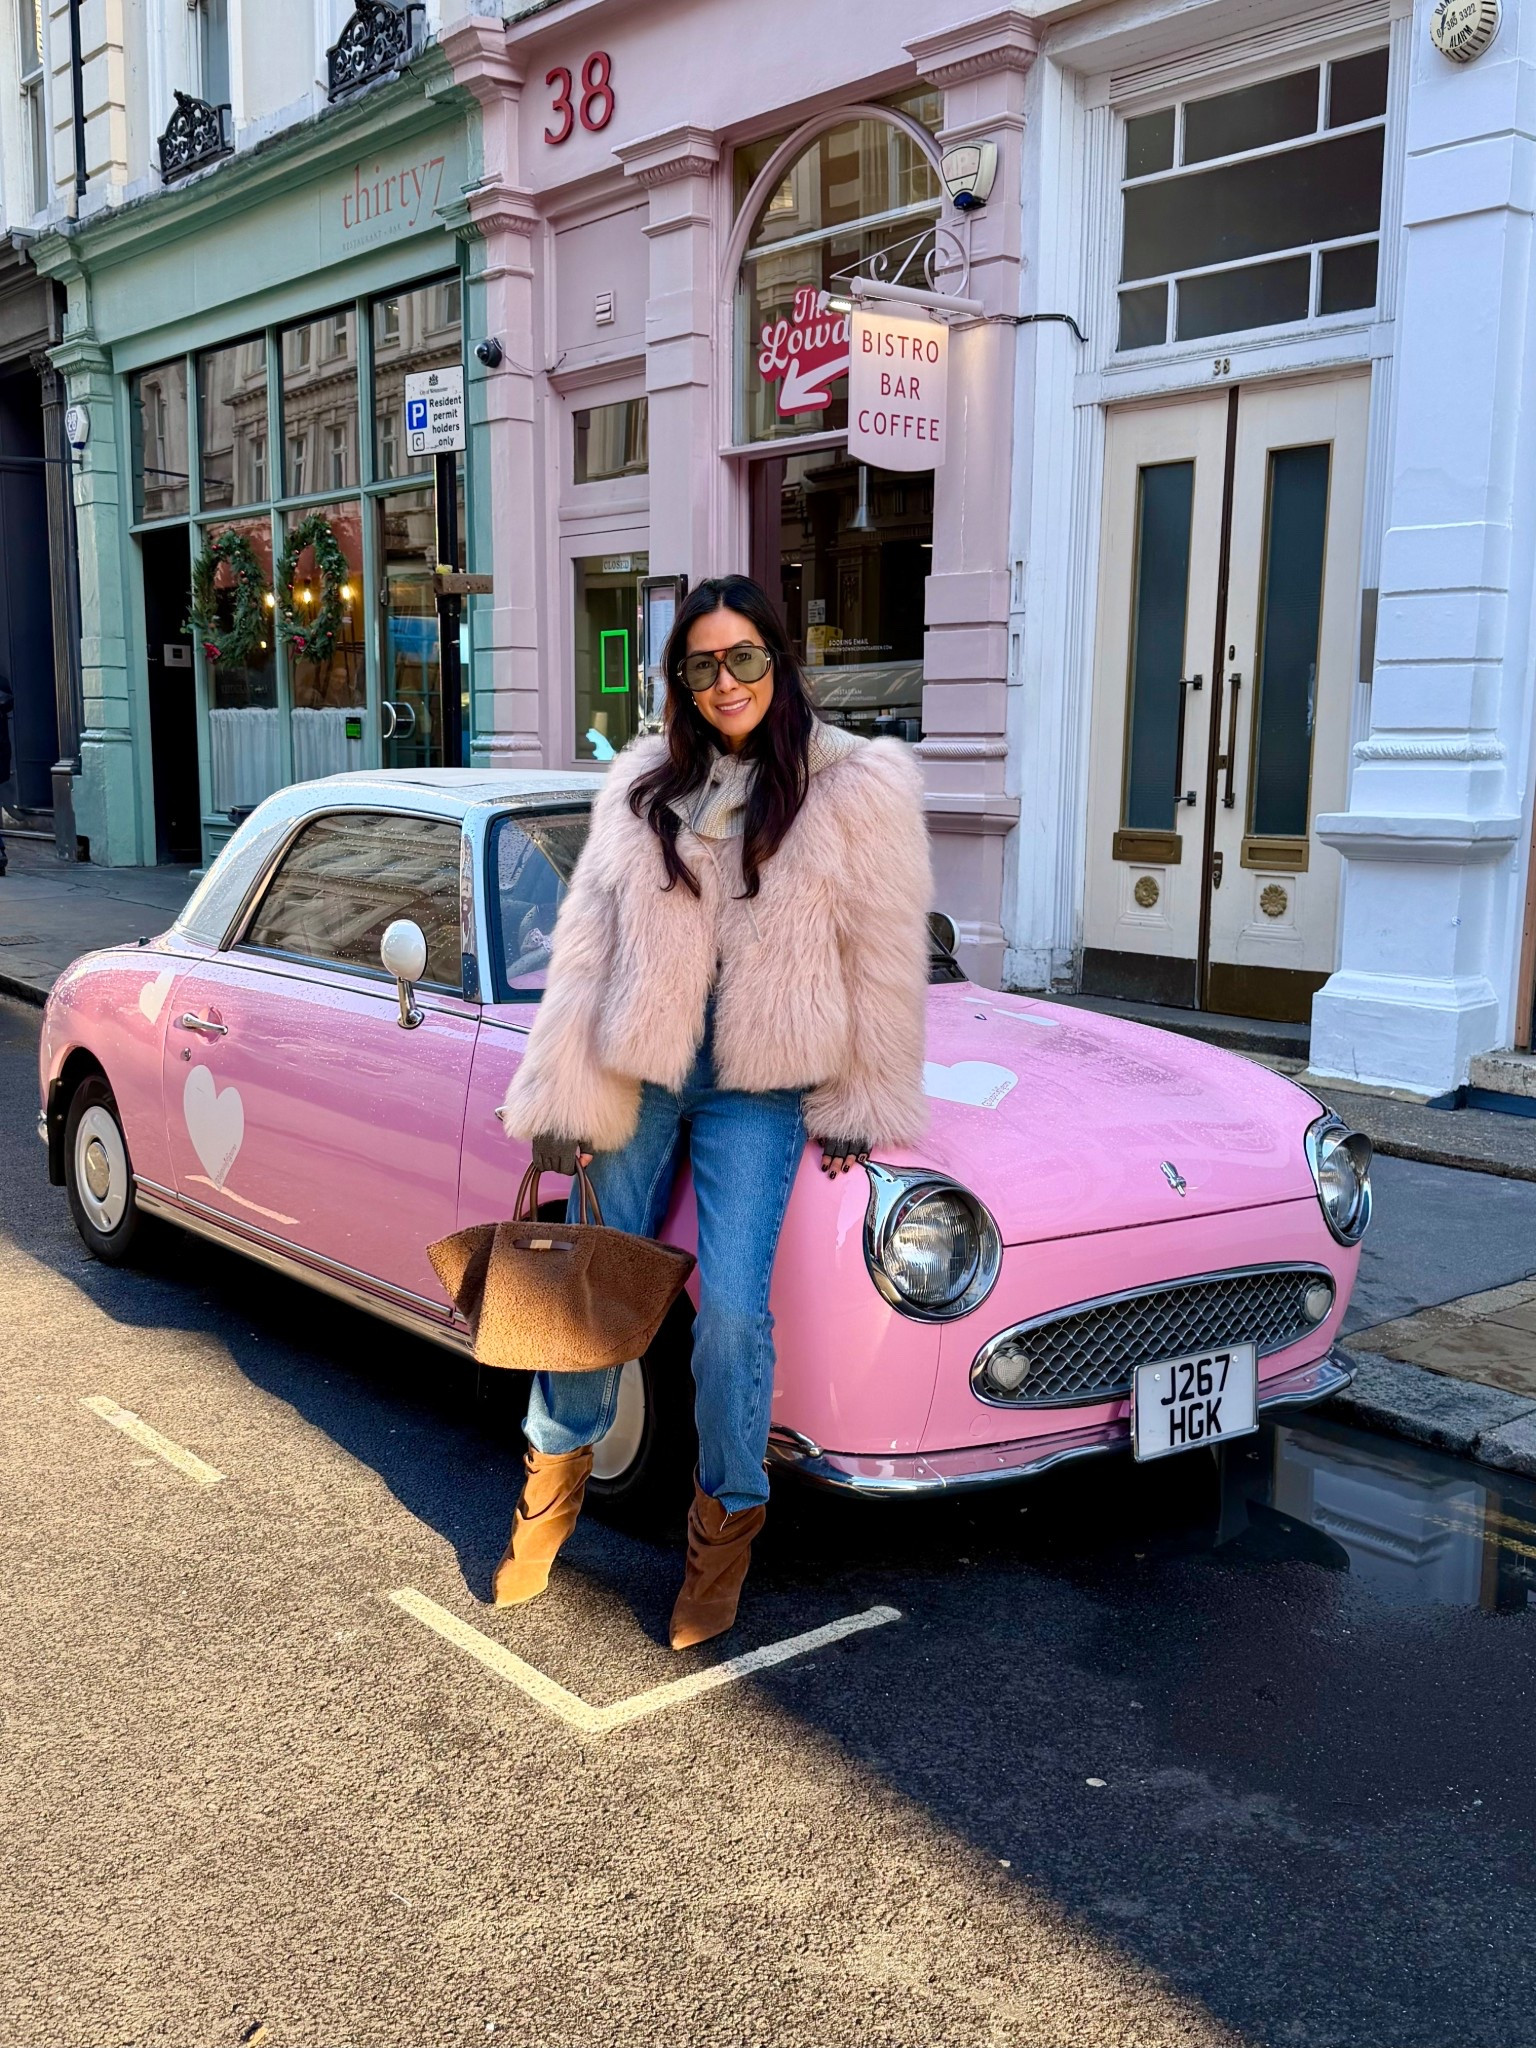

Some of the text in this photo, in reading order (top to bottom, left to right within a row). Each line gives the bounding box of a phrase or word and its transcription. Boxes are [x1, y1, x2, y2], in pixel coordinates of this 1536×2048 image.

[1458, 3, 1477, 21] 3322
[1449, 24, 1474, 48] ALARM
[545, 51, 615, 145] 38
[342, 156, 445, 228] thirty7
[862, 329, 939, 363] BISTRO
[1213, 358, 1230, 376] 38
[881, 372, 920, 400] BAR
[429, 396, 462, 408] Resident
[433, 409, 458, 422] permit
[858, 410, 940, 441] COFFEE
[432, 423, 460, 434] holders
[438, 436, 455, 447] only
[603, 560, 629, 570] CLOSED
[1160, 1353, 1230, 1407] J267
[1170, 1397, 1222, 1446] HGK
